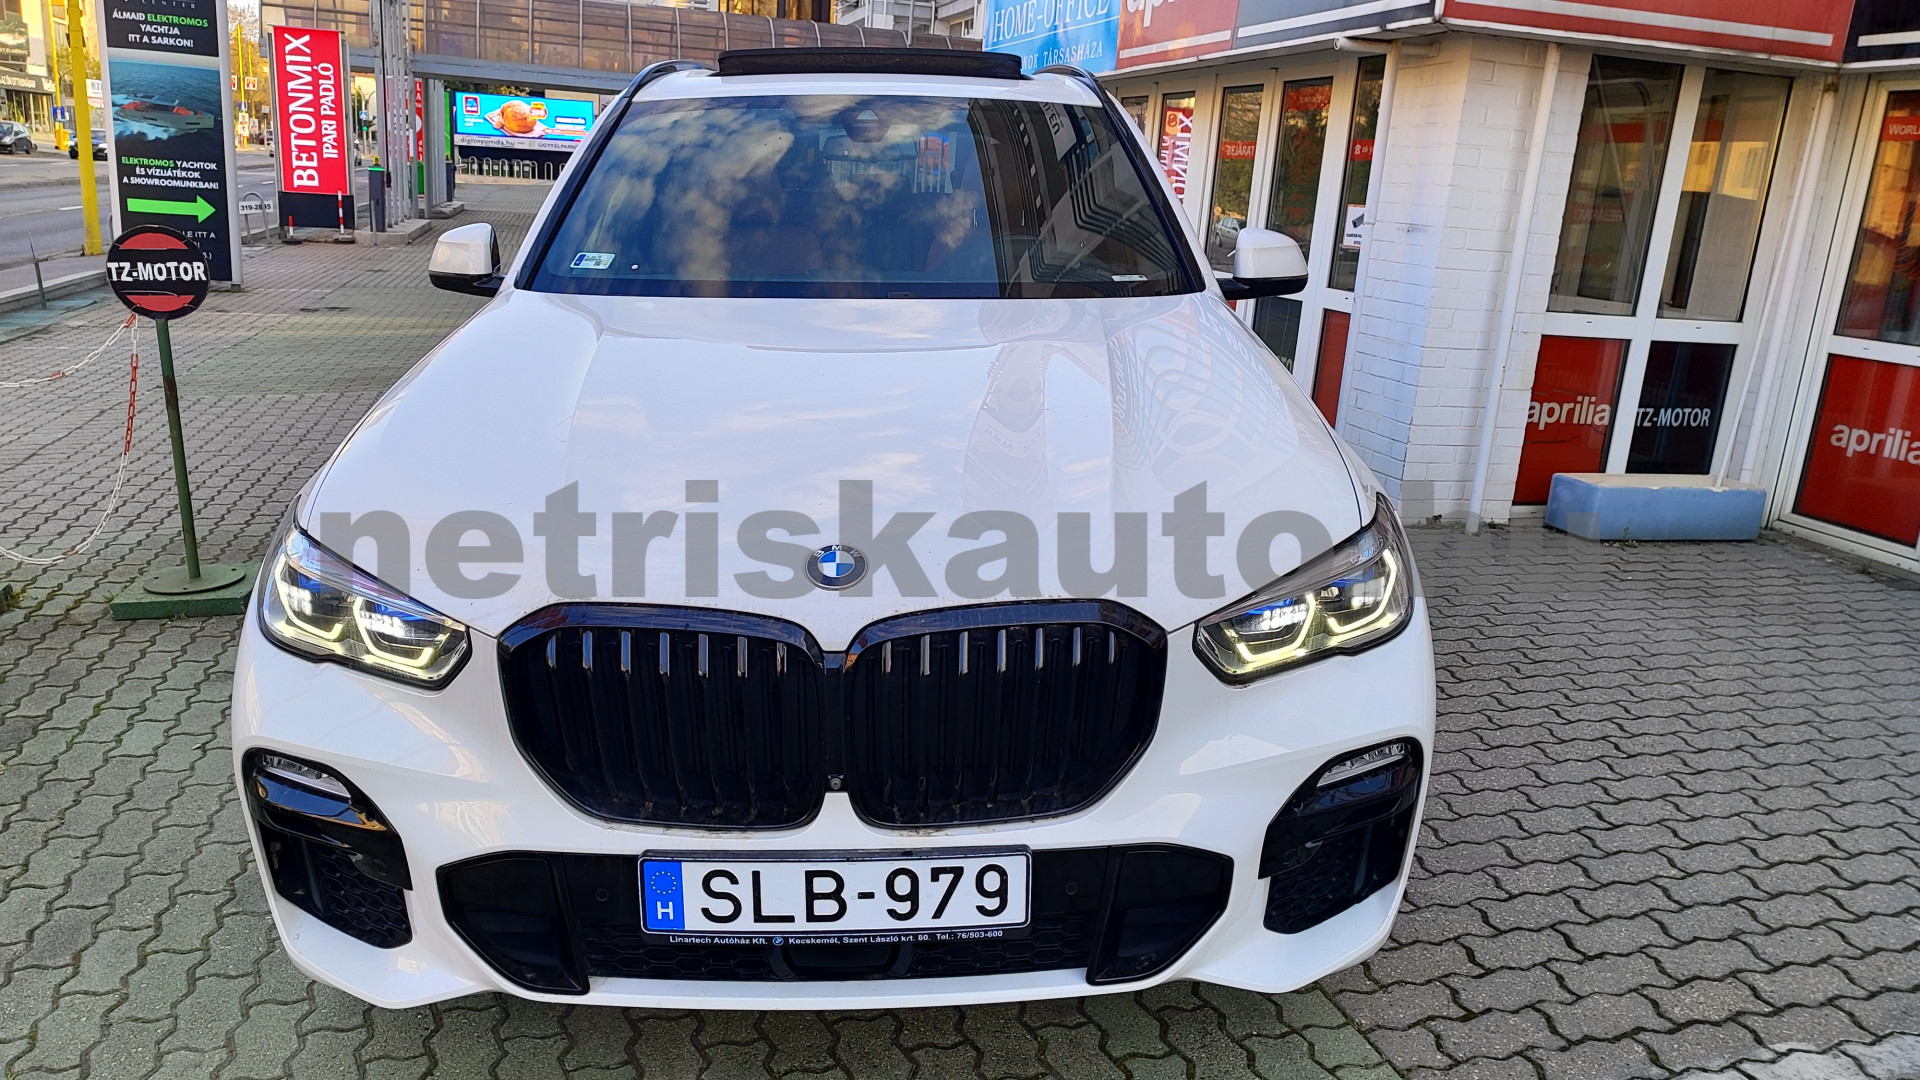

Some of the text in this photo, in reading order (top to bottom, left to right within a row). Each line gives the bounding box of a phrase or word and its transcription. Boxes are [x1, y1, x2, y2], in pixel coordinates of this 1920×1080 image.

[112, 8, 208, 28] ÁLMAID ELEKTROMOS
[139, 23, 180, 35] YACHTJA
[128, 34, 194, 48] ITT A SARKON!
[1043, 40, 1103, 66] TÁRSASHÁZA
[284, 33, 319, 188] BETONMIX
[313, 62, 339, 159] IPARI PADLÓ
[1888, 124, 1920, 136] WORL
[121, 157, 218, 170] ELEKTROMOS YACHTOK
[135, 165, 145, 175] ÉS
[130, 177, 219, 190] SHOWROOMUNKBAN!
[209, 231, 216, 239] A
[106, 261, 207, 282] TZ-MOTOR
[1527, 395, 1611, 431] aprilia
[1636, 407, 1711, 428] TZ-MOTOR
[1830, 424, 1920, 466] aprilia
[657, 863, 1010, 924] H SLB-979
[669, 935, 711, 944] Linartech
[713, 936, 750, 945] Autóház
[752, 937, 768, 945] Kft.
[788, 936, 841, 945] Kecskemét,
[842, 936, 868, 944] Szent
[870, 935, 899, 943] László
[901, 934, 916, 942] krt.
[956, 930, 1003, 940] 76/503-600
